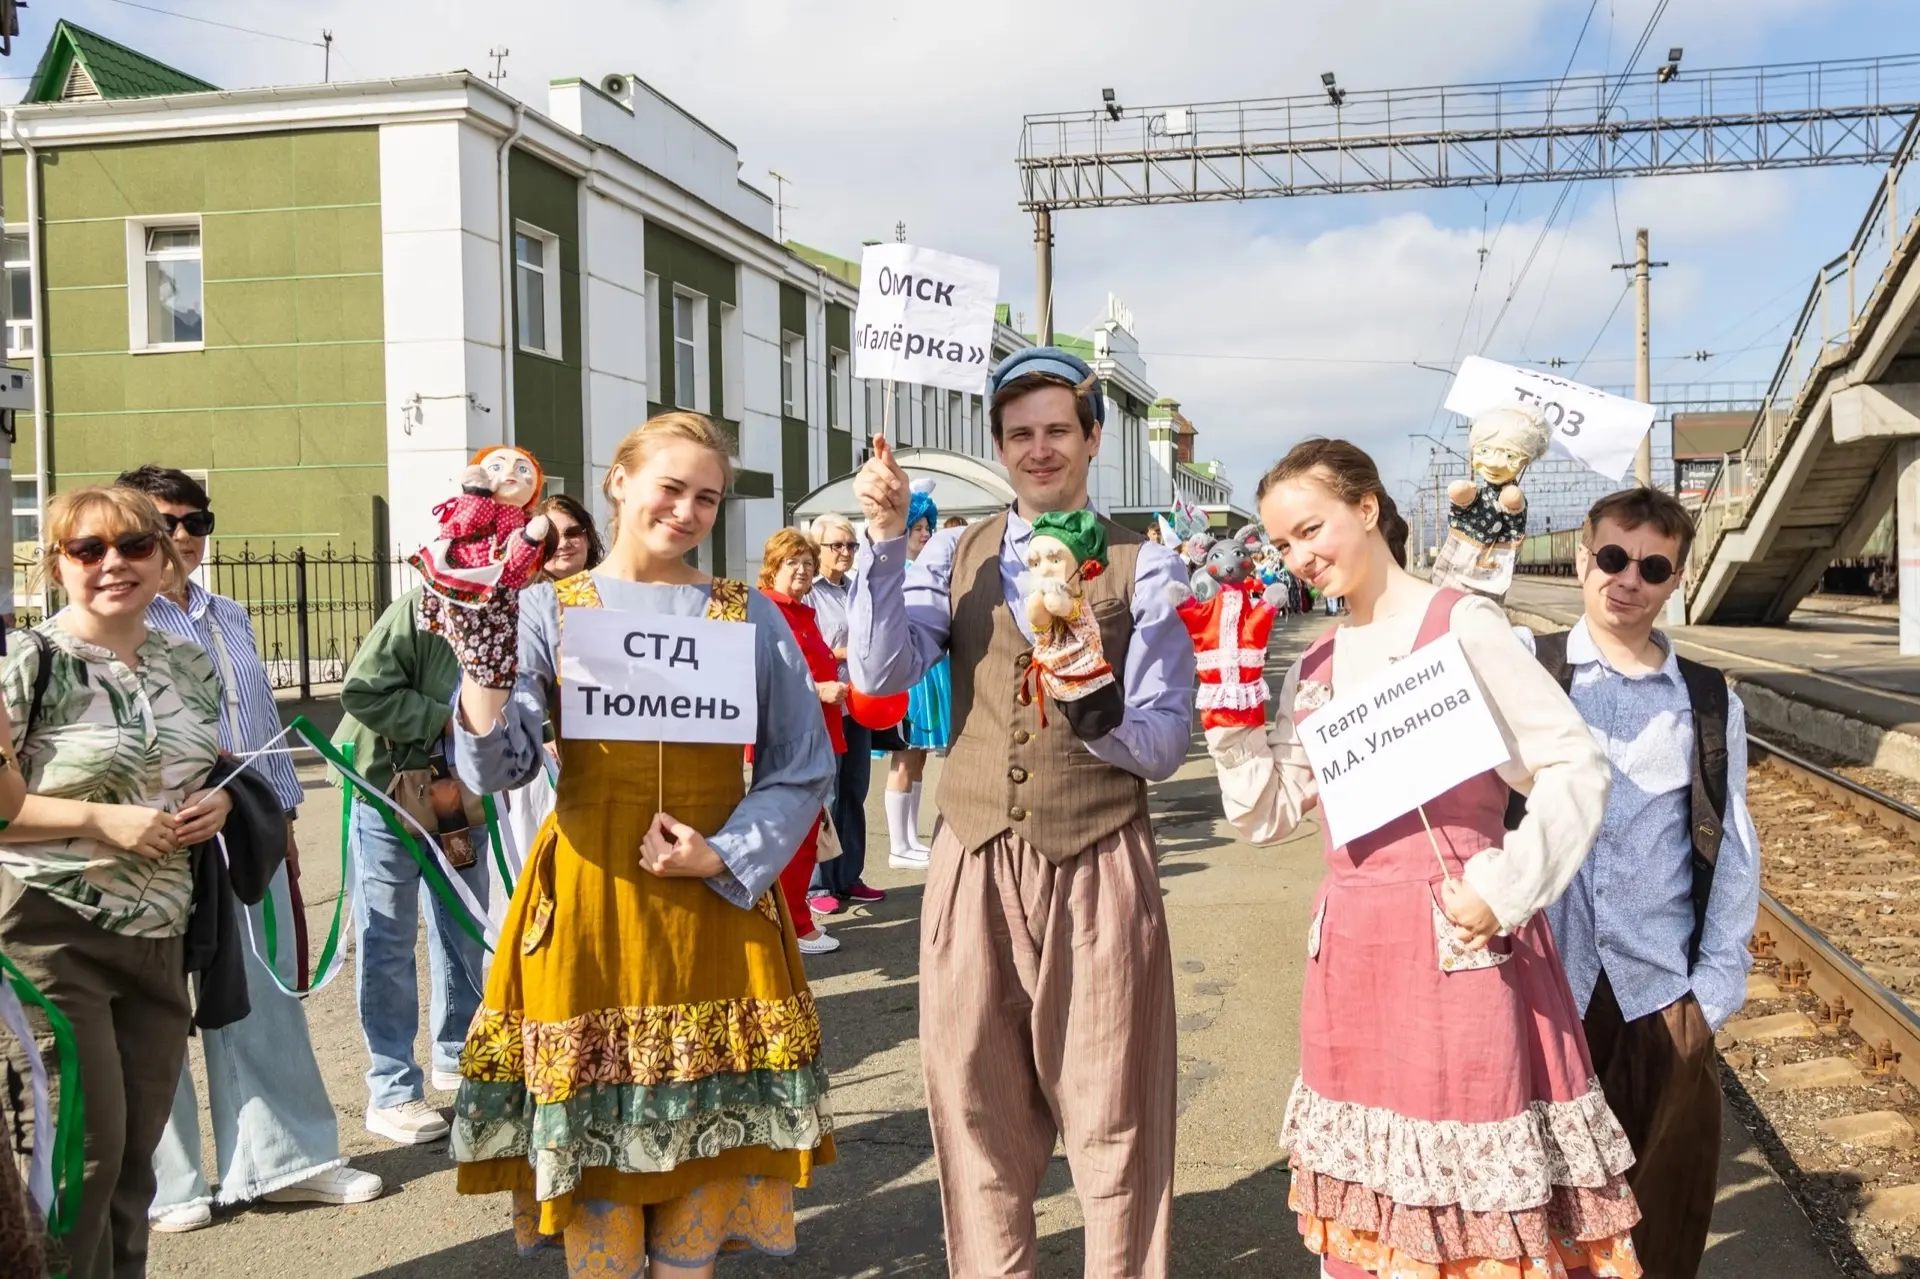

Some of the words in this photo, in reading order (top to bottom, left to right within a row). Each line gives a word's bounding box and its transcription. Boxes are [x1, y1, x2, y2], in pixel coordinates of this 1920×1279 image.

[879, 266, 955, 306] Омск
[857, 324, 985, 364] «Галёрка»
[623, 631, 699, 670] СТД
[578, 686, 741, 720] Тюмень
[1316, 703, 1369, 744] Театр
[1373, 660, 1445, 709] имени
[1321, 750, 1365, 784] М.А.
[1364, 687, 1471, 754] Ульянова
